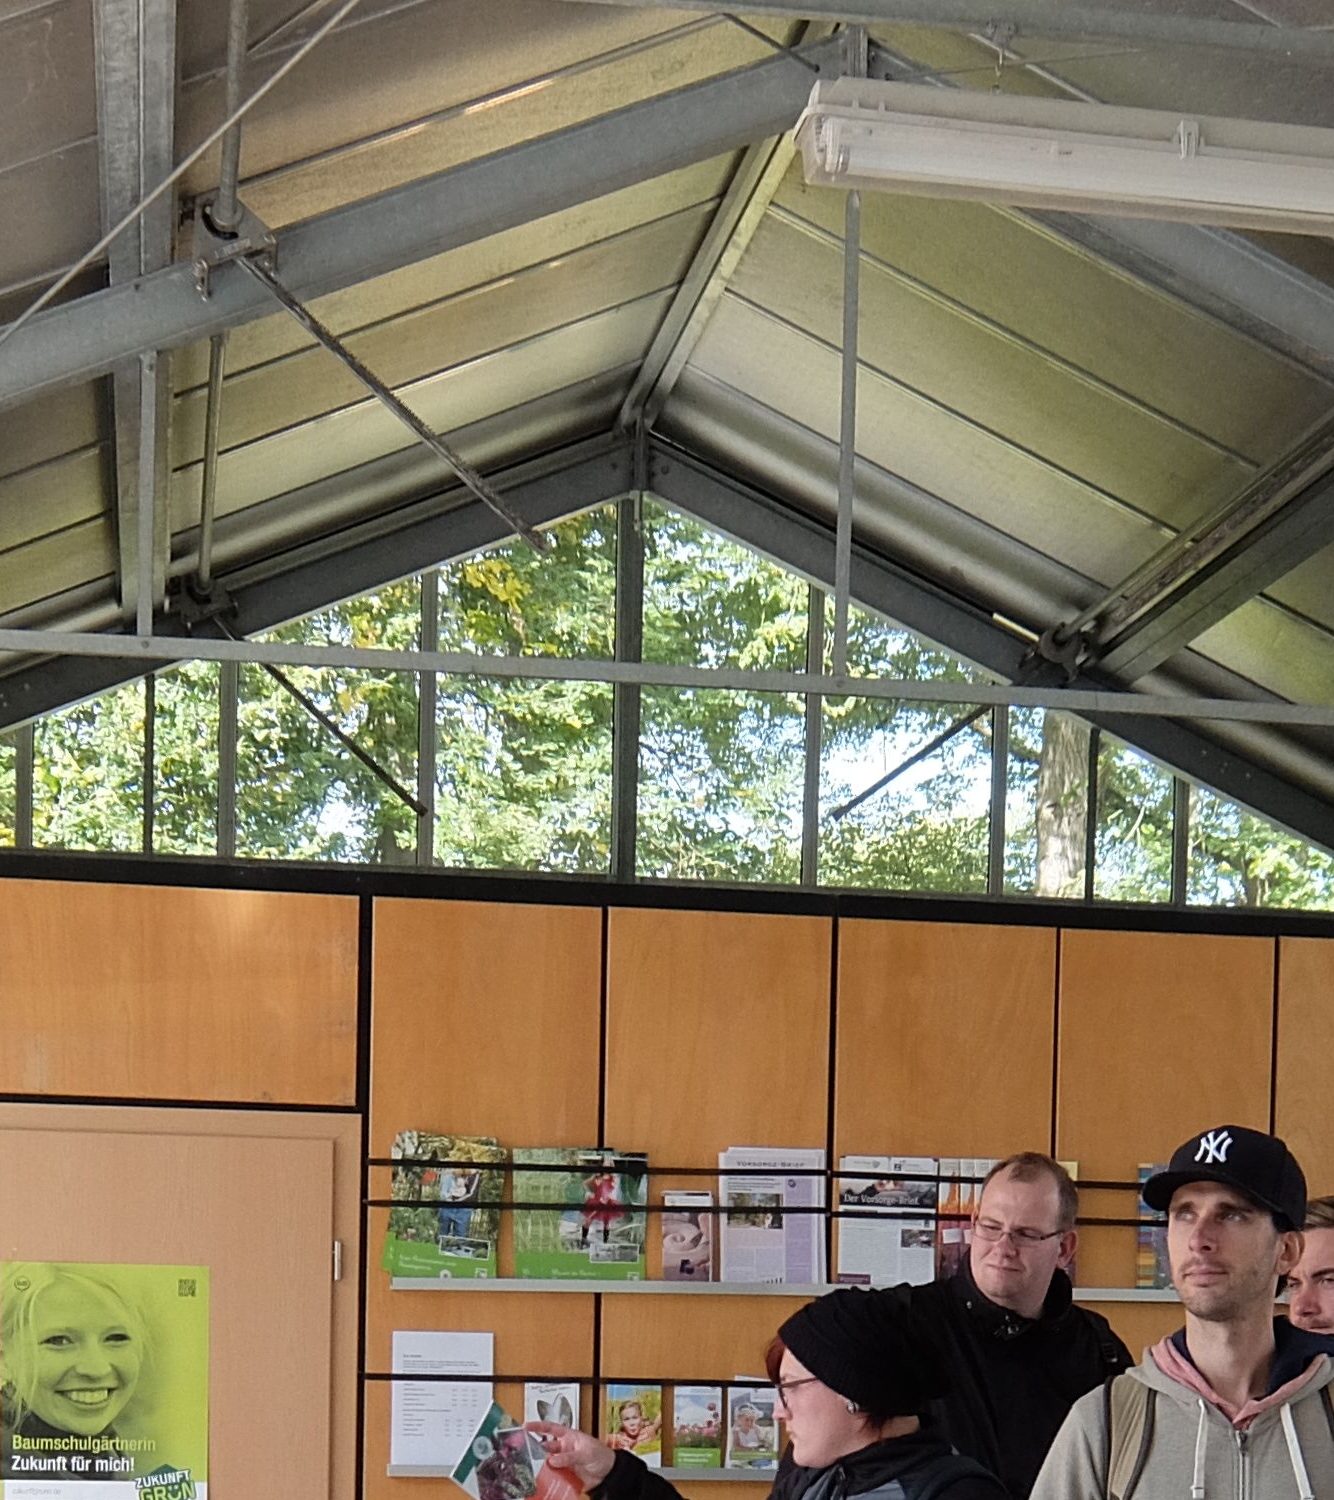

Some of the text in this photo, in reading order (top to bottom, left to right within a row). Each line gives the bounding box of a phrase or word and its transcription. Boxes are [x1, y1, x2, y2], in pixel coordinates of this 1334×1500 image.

[1194, 1130, 1234, 1163] NY
[12, 1434, 156, 1454] Baumschulgärtnerin
[11, 1455, 135, 1473] Zukunft für mich!
[135, 1470, 190, 1488] ZUKUNFT
